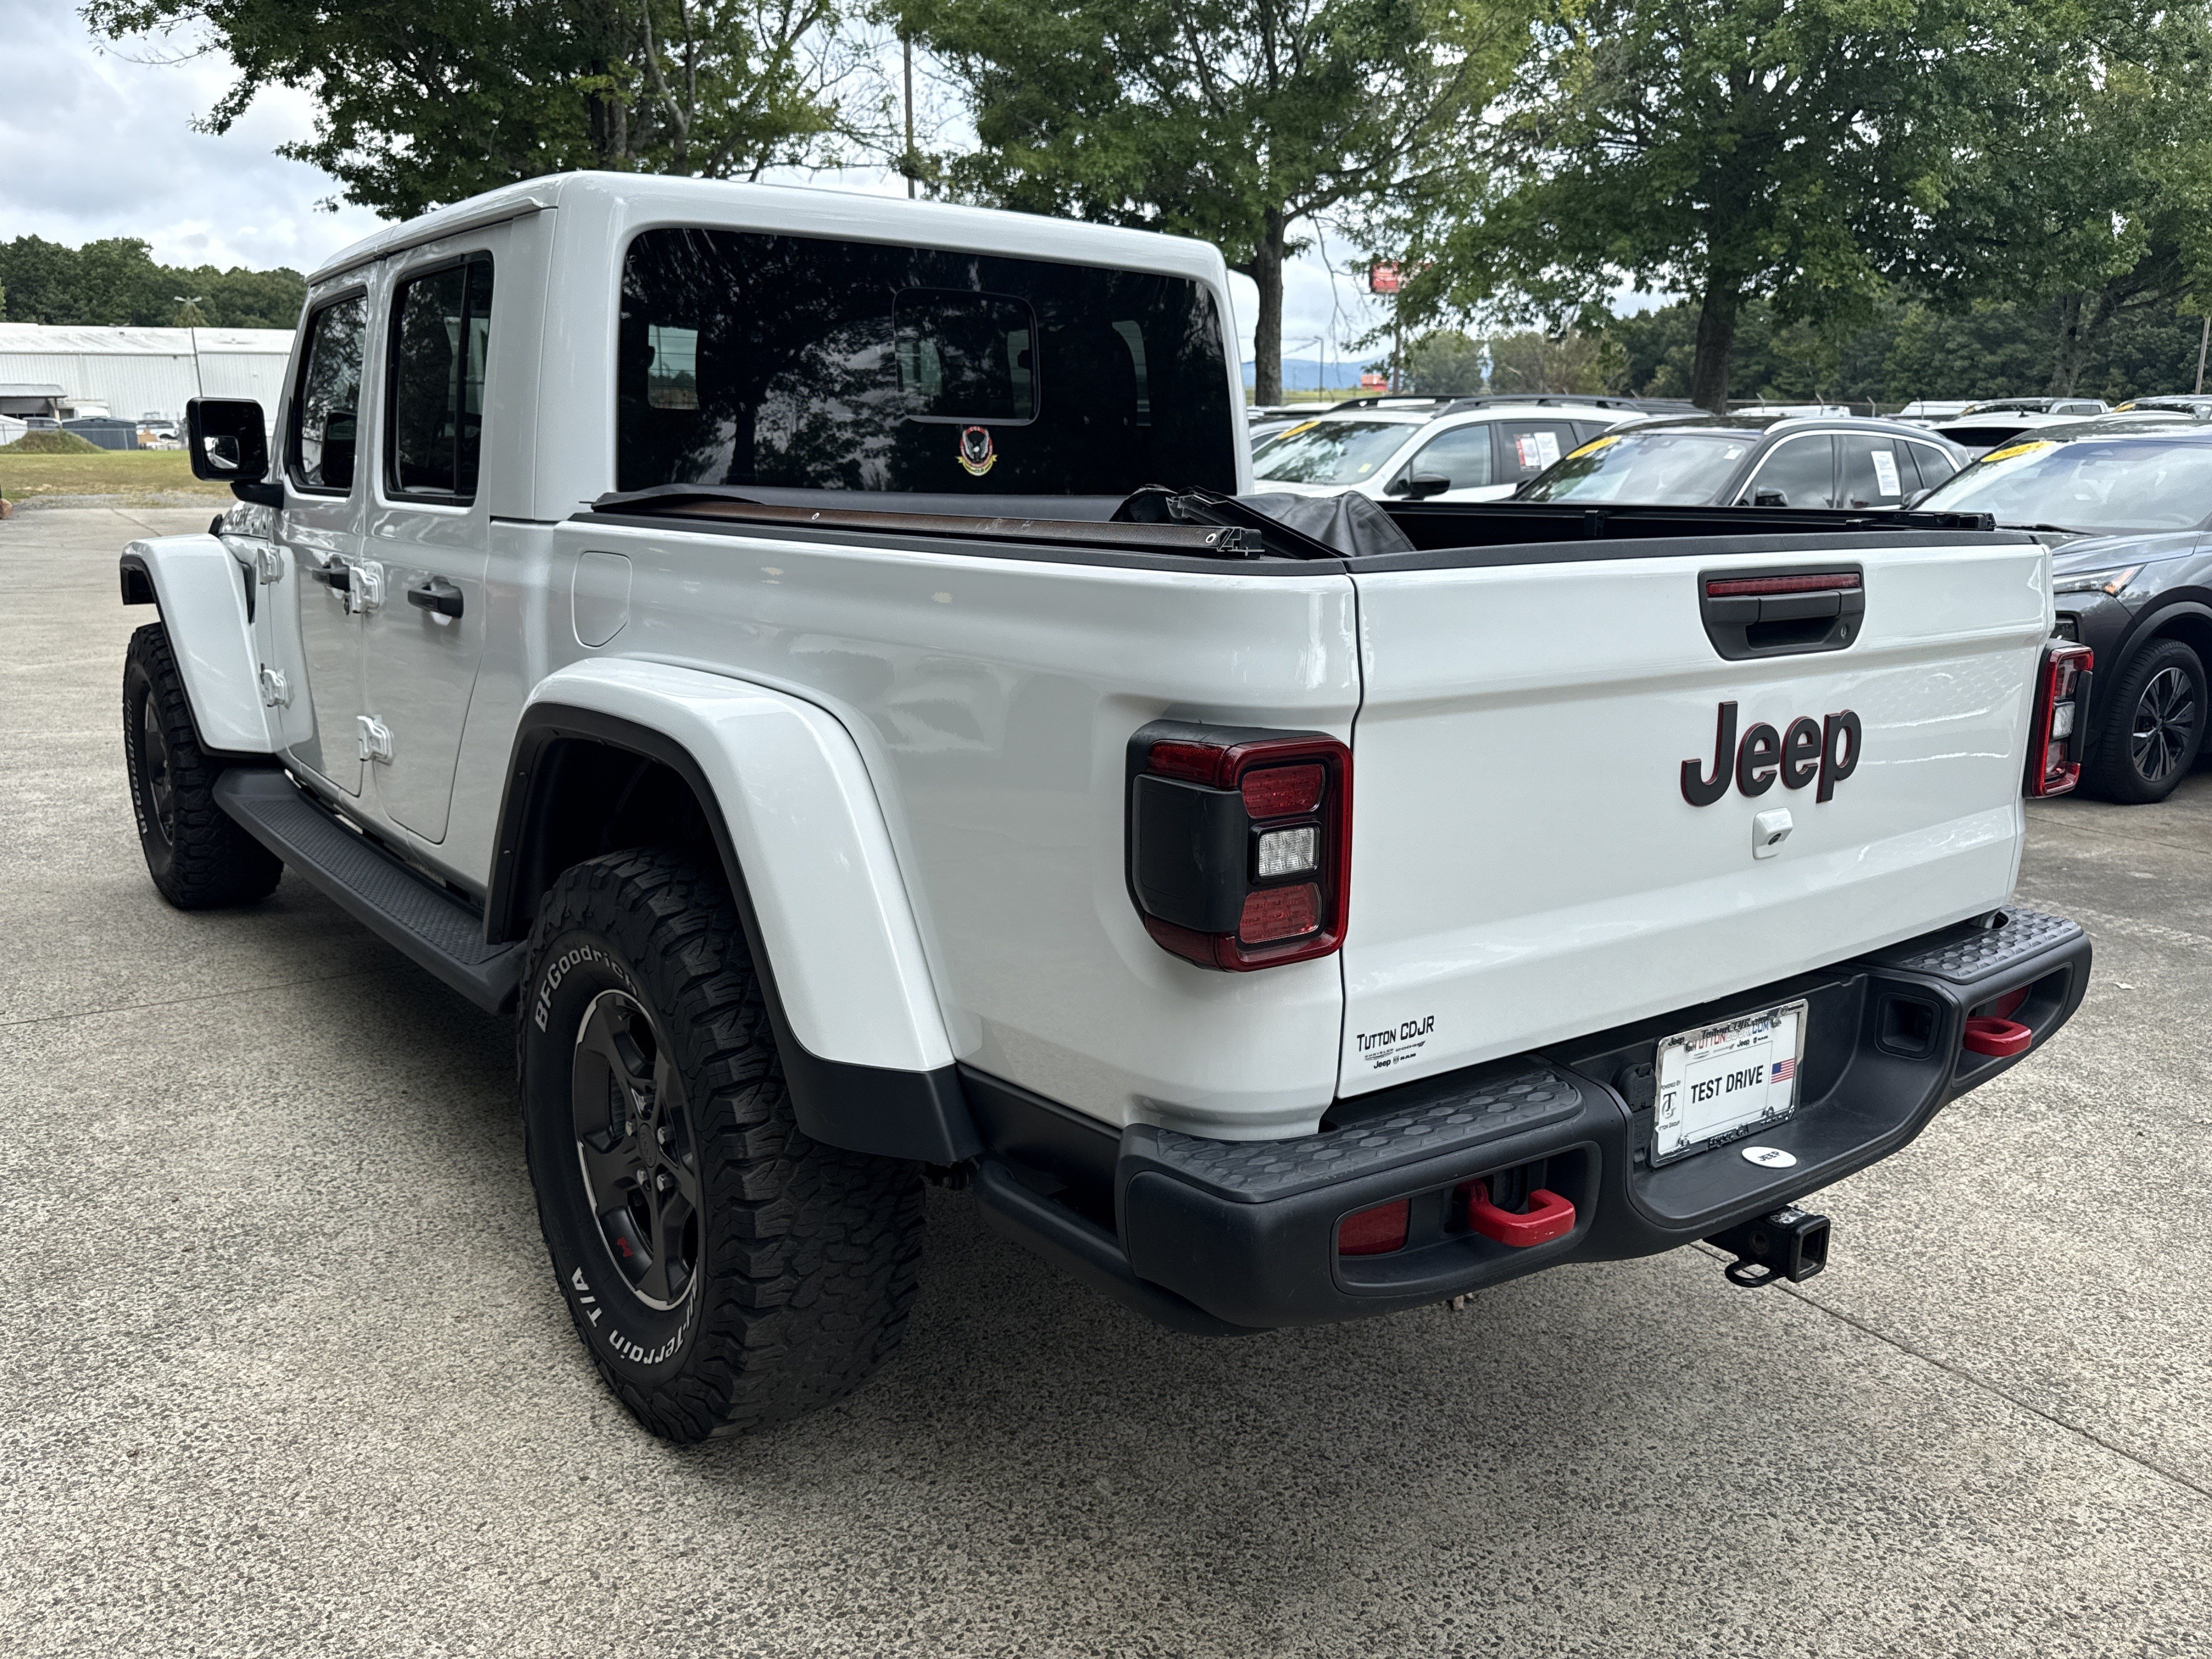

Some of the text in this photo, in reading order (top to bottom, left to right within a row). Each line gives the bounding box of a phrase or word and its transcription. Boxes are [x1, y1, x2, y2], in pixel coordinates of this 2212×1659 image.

[1680, 701, 1862, 806] Jeep
[535, 945, 638, 1033] BFGoodrich
[1401, 1015, 1434, 1040] CDJR
[1374, 1053, 1416, 1069] Jeep RAM
[1691, 1065, 1763, 1104] TEST DRIVE
[1758, 1151, 1780, 1161] JEEP
[572, 1267, 602, 1327] T/A
